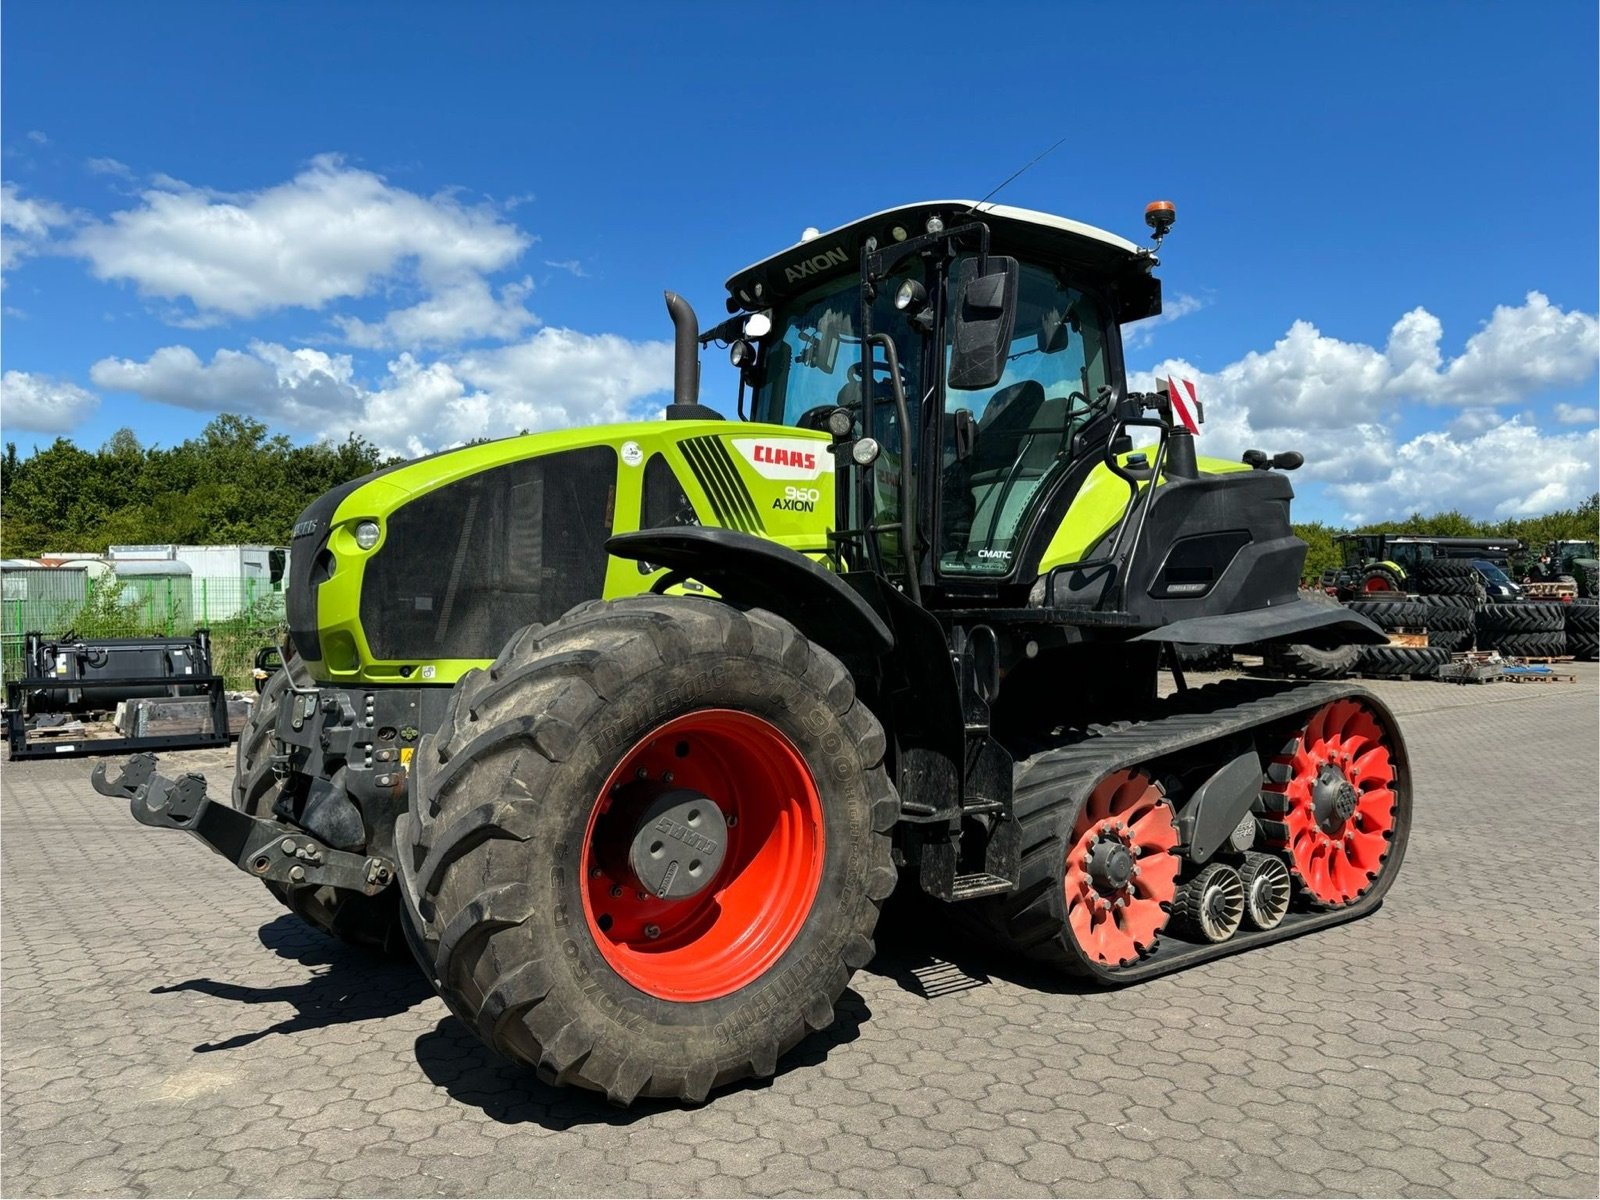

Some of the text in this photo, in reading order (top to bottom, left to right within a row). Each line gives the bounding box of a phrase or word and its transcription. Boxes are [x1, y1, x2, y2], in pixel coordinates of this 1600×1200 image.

[784, 246, 849, 284] AXION
[753, 445, 816, 470] CLAAS
[772, 498, 814, 513] AXION
[784, 486, 820, 502] 960
[977, 549, 1012, 559] CMATIC
[586, 664, 727, 759] TRELLEBORG
[801, 708, 854, 782] 900
[655, 817, 718, 856] CLAAS
[712, 938, 839, 1048] TRELLEBORG
